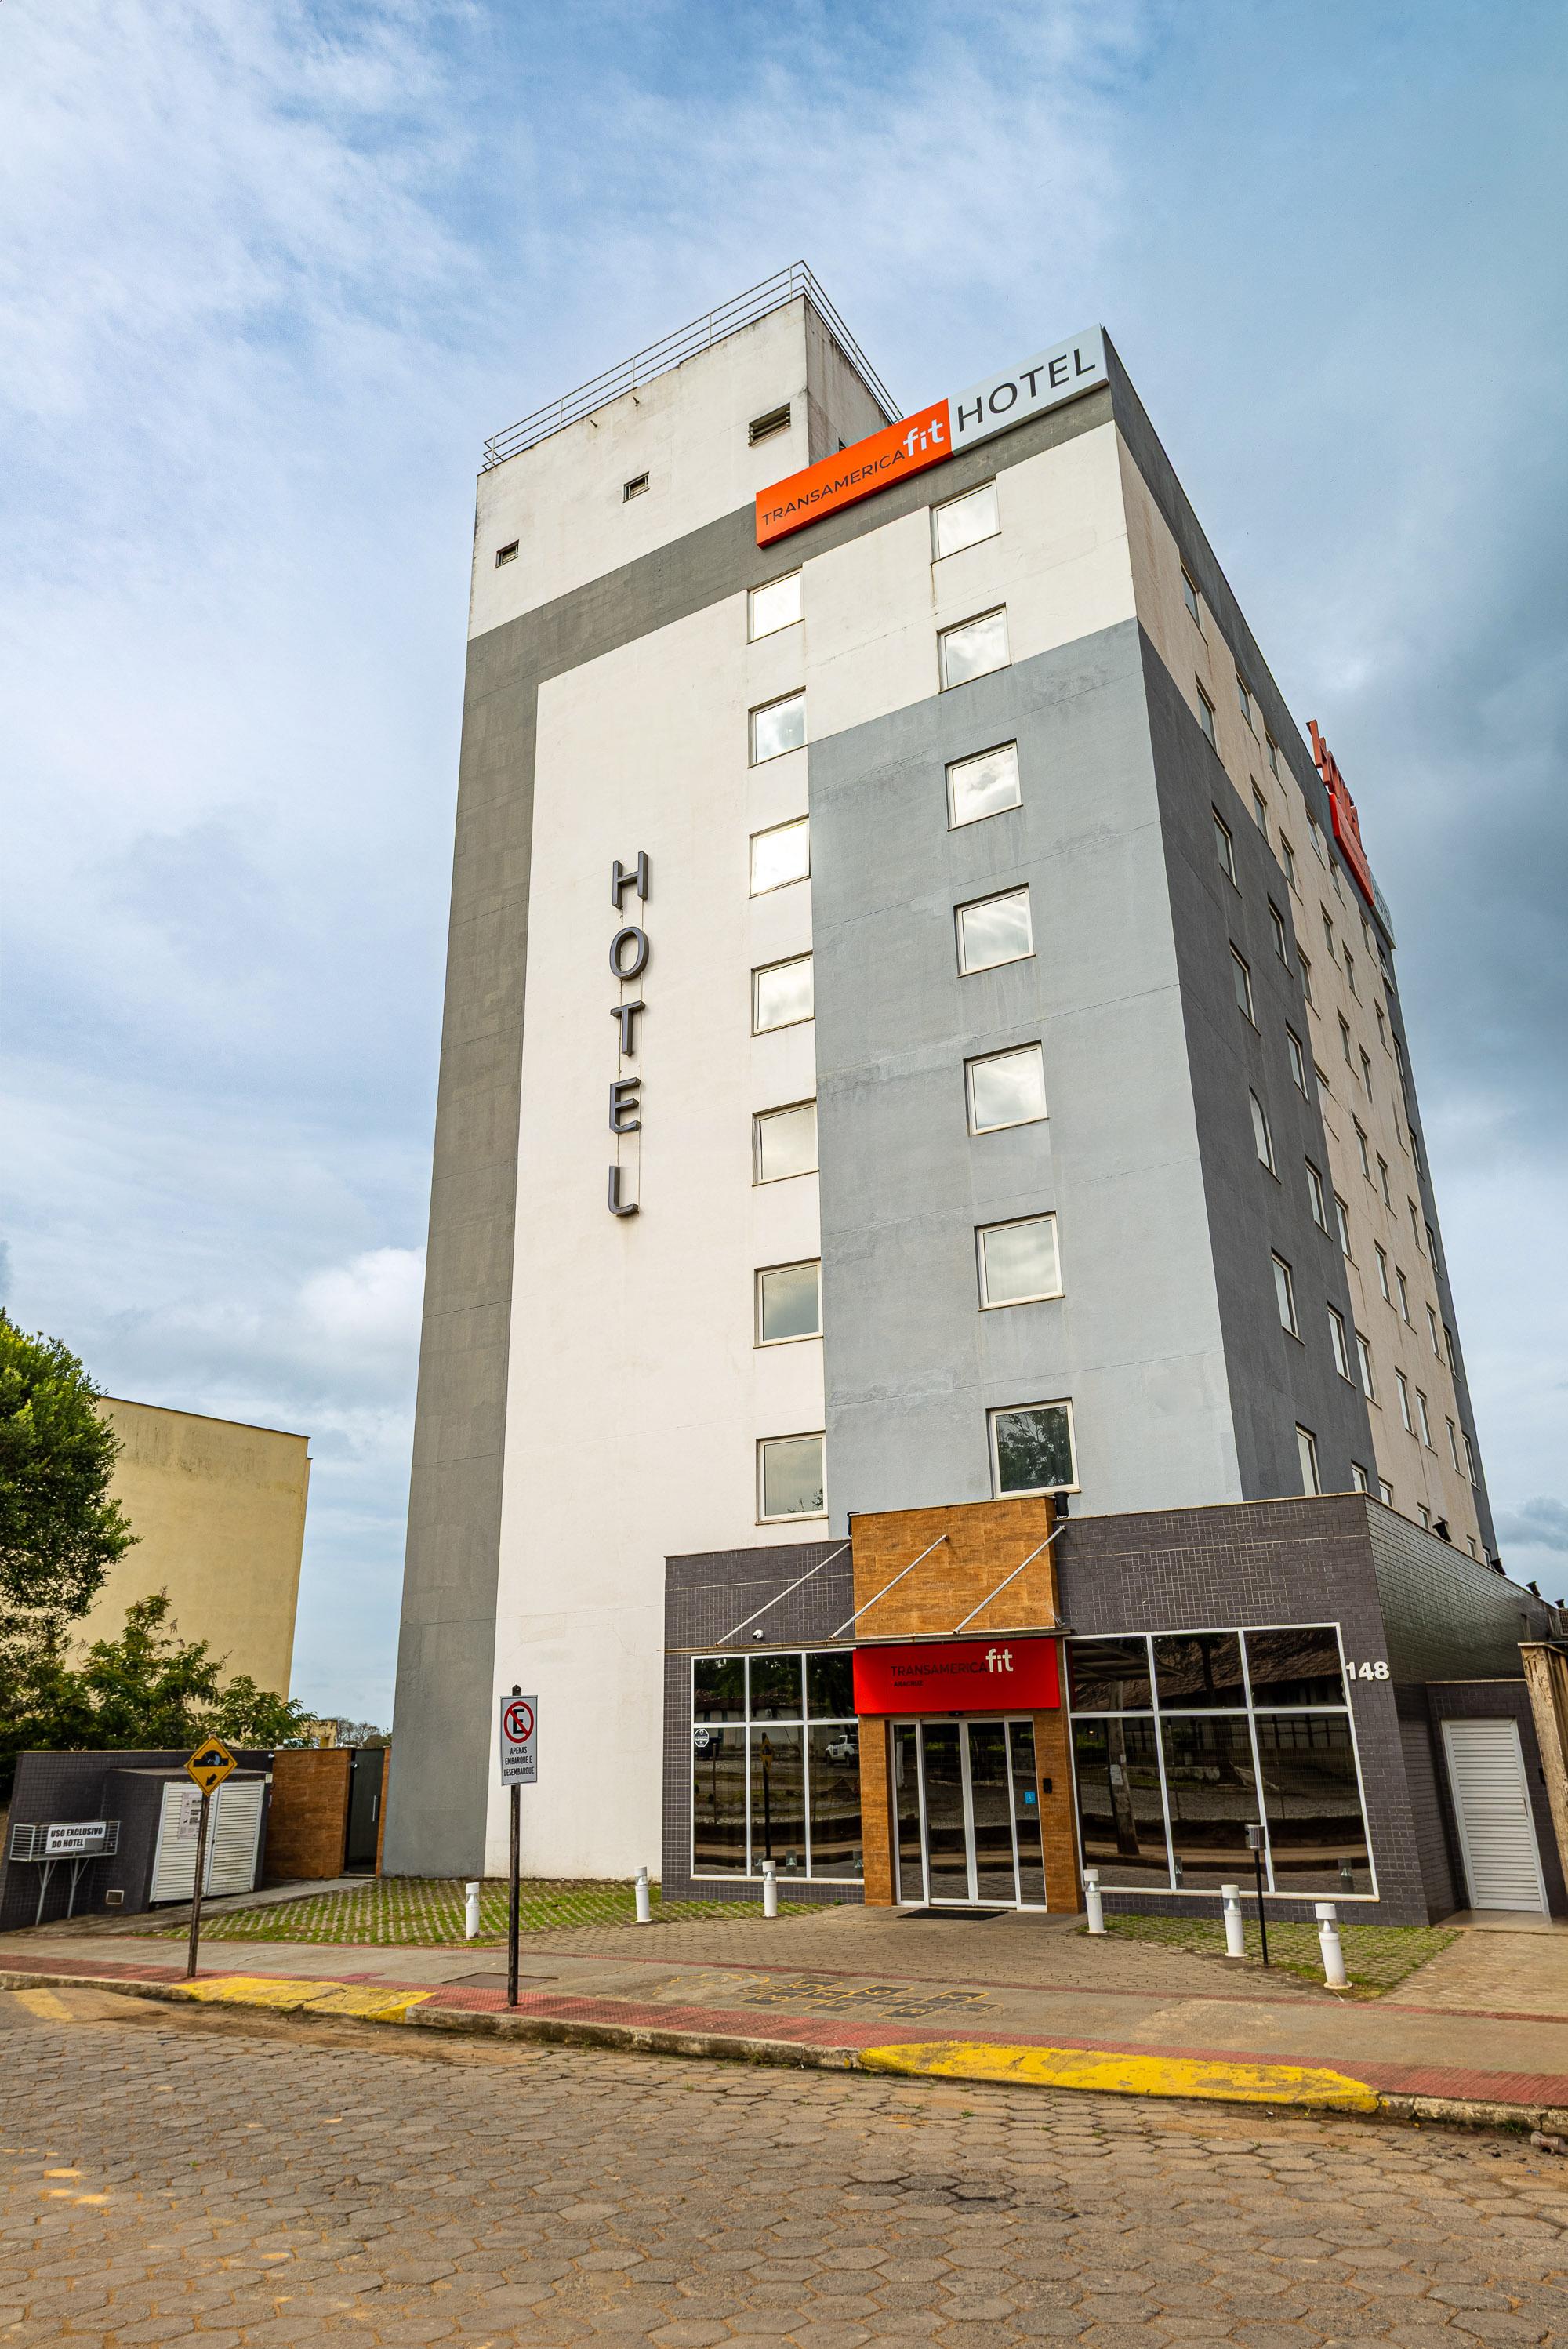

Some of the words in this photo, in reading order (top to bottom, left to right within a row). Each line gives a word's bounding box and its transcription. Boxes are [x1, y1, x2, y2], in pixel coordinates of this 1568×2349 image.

[762, 450, 905, 526] TRANSAMERICA
[903, 419, 944, 457] fit
[958, 348, 1096, 432] HOTEL
[608, 851, 649, 1217] HOTEL
[890, 1661, 988, 1676] TRANSAMERICA
[985, 1648, 1014, 1672] fit
[1345, 1661, 1390, 1680] 148
[513, 1708, 526, 1734] E
[510, 1746, 528, 1755] APENAS
[505, 1756, 528, 1765] EMBARQUE
[503, 1766, 535, 1777] DESEMBARQUE
[66, 1827, 103, 1836] EXCLUSIVO
[63, 1839, 83, 1847] HOTEL
